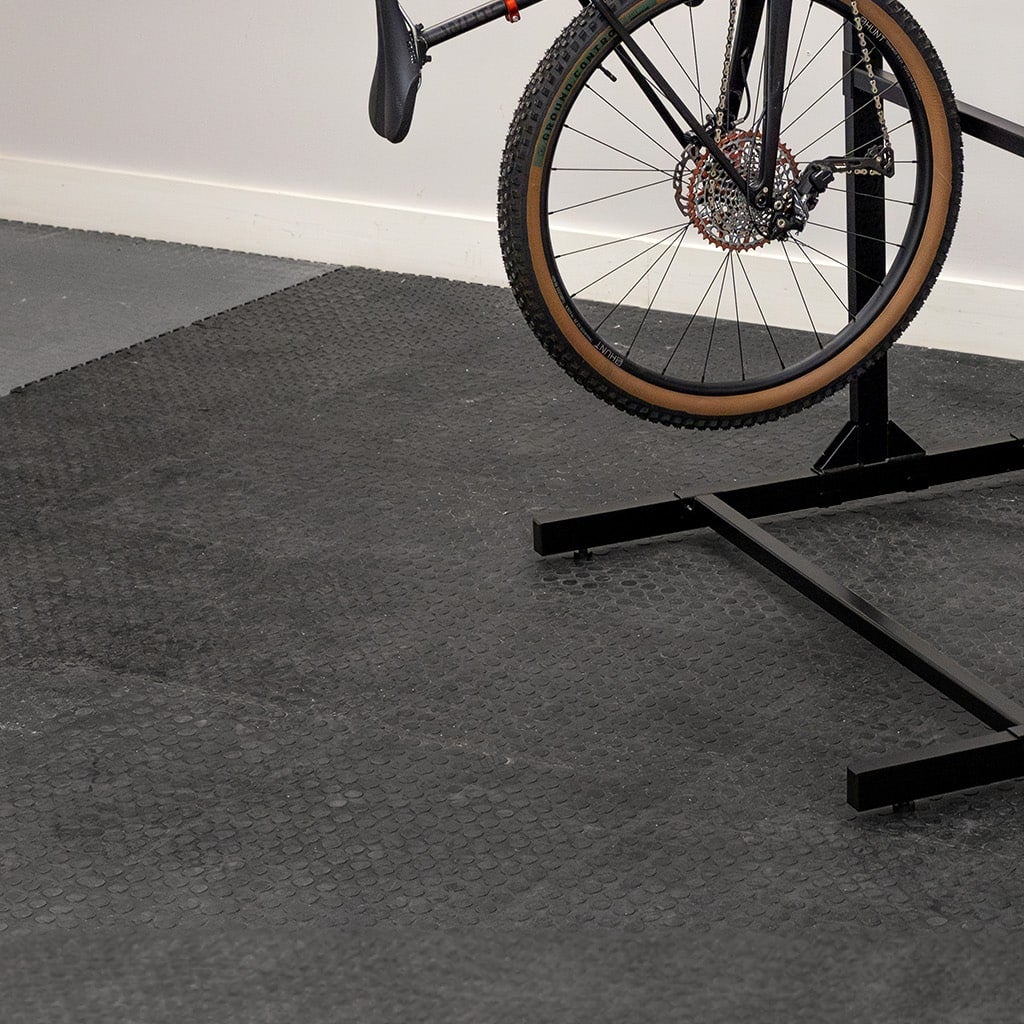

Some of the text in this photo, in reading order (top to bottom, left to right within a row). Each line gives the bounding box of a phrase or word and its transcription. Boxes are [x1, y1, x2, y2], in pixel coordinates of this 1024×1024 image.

[865, 20, 887, 42] HUNT
[542, 28, 618, 145] GROUND CONTRO
